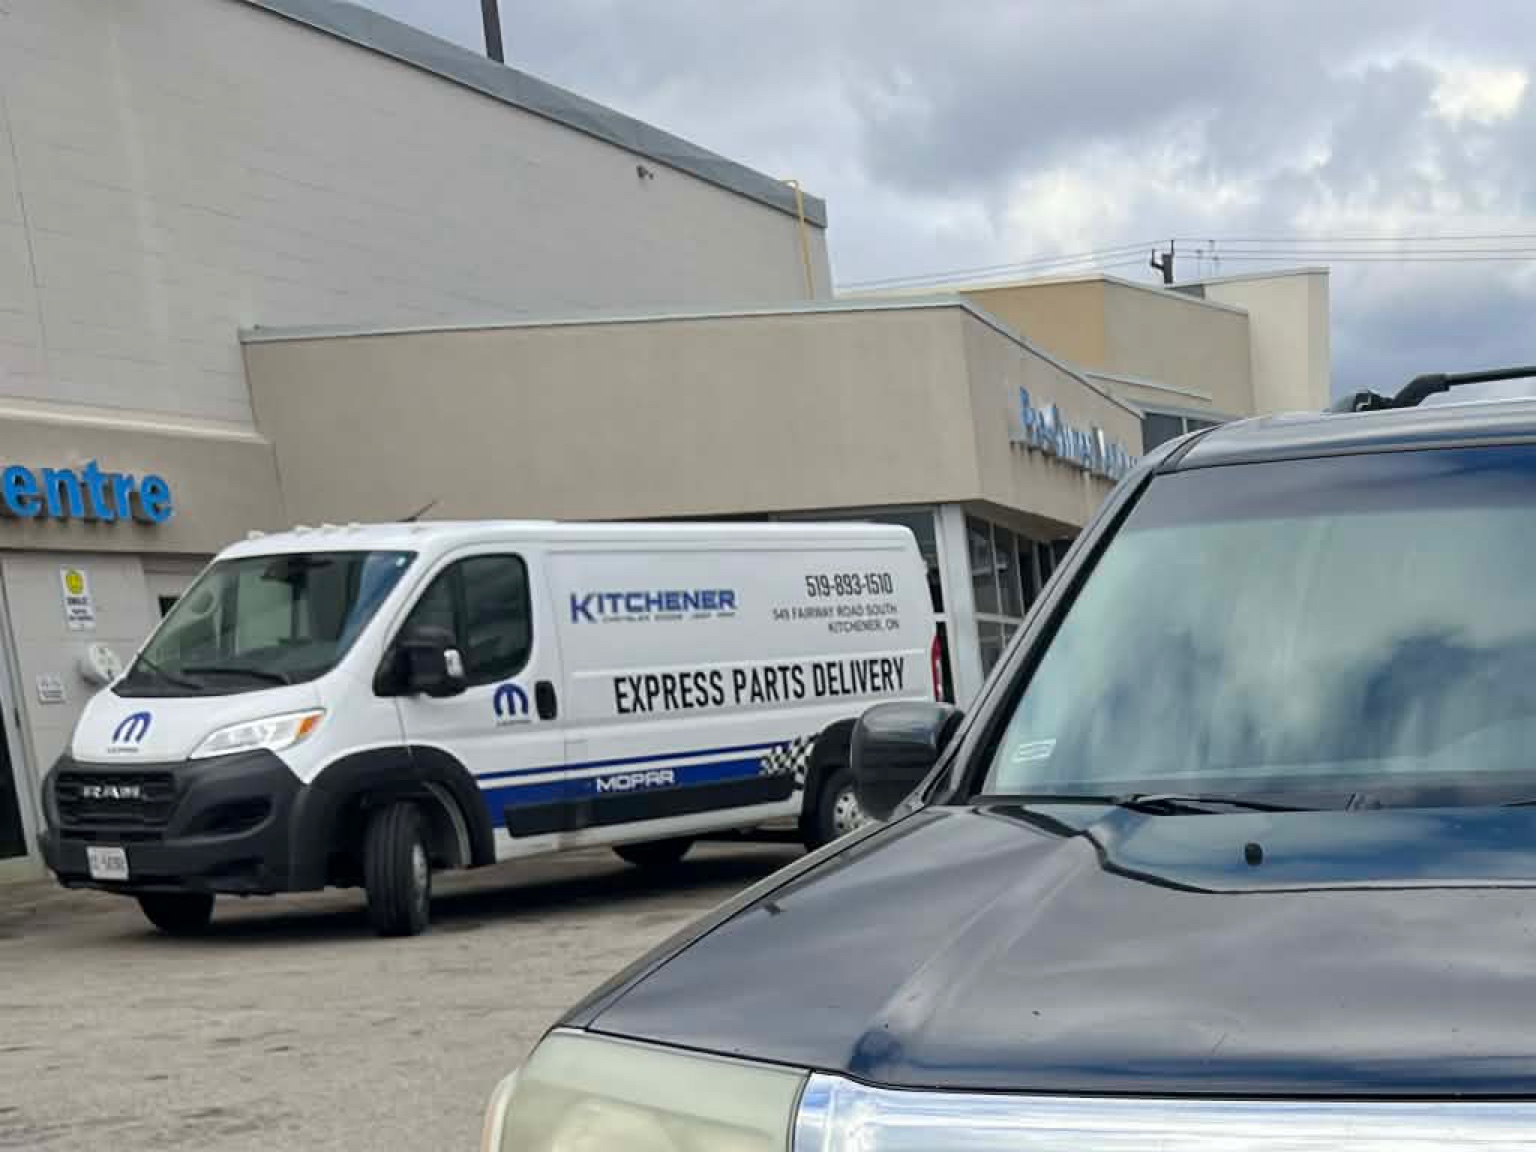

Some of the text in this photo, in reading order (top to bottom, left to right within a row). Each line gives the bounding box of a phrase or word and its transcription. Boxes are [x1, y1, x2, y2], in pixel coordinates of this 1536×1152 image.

[2, 459, 171, 523] entre
[805, 572, 894, 598] 519-893-1510
[570, 589, 736, 624] KITCHENER
[613, 657, 905, 714] EXPRESS PARTS DELIVERY
[596, 769, 676, 793] MOPAR
